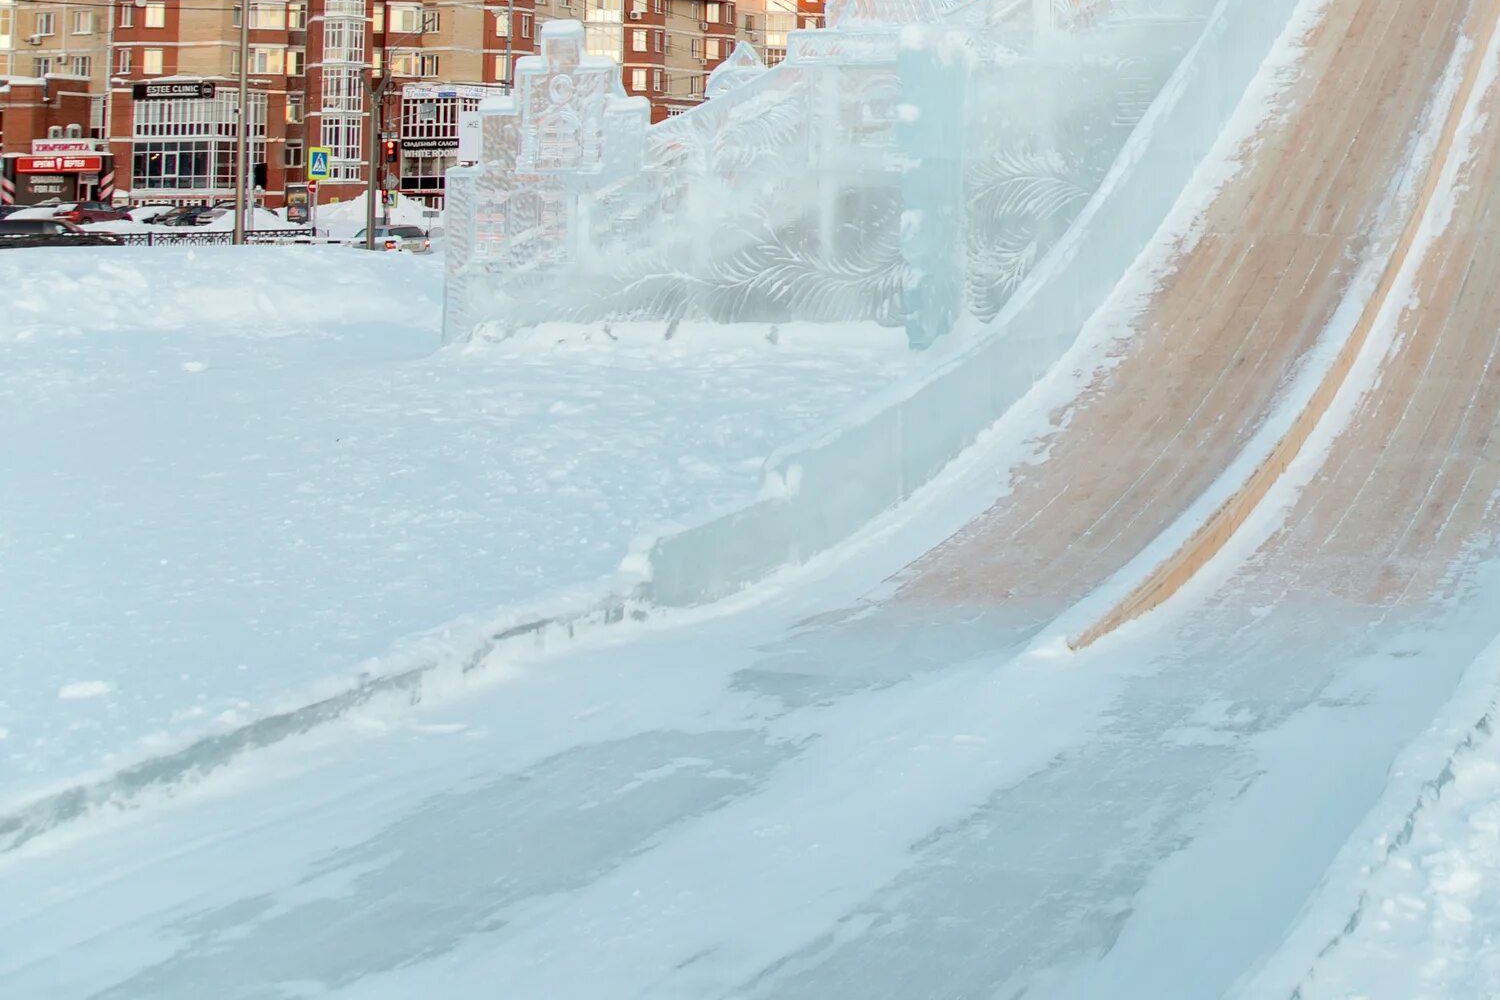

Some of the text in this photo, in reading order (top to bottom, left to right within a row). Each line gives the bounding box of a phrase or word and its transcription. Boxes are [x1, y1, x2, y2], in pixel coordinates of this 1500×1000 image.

[146, 85, 171, 93] ESTEE
[404, 149, 458, 157] WHITE ROOM
[33, 185, 62, 193] FOR ALL
